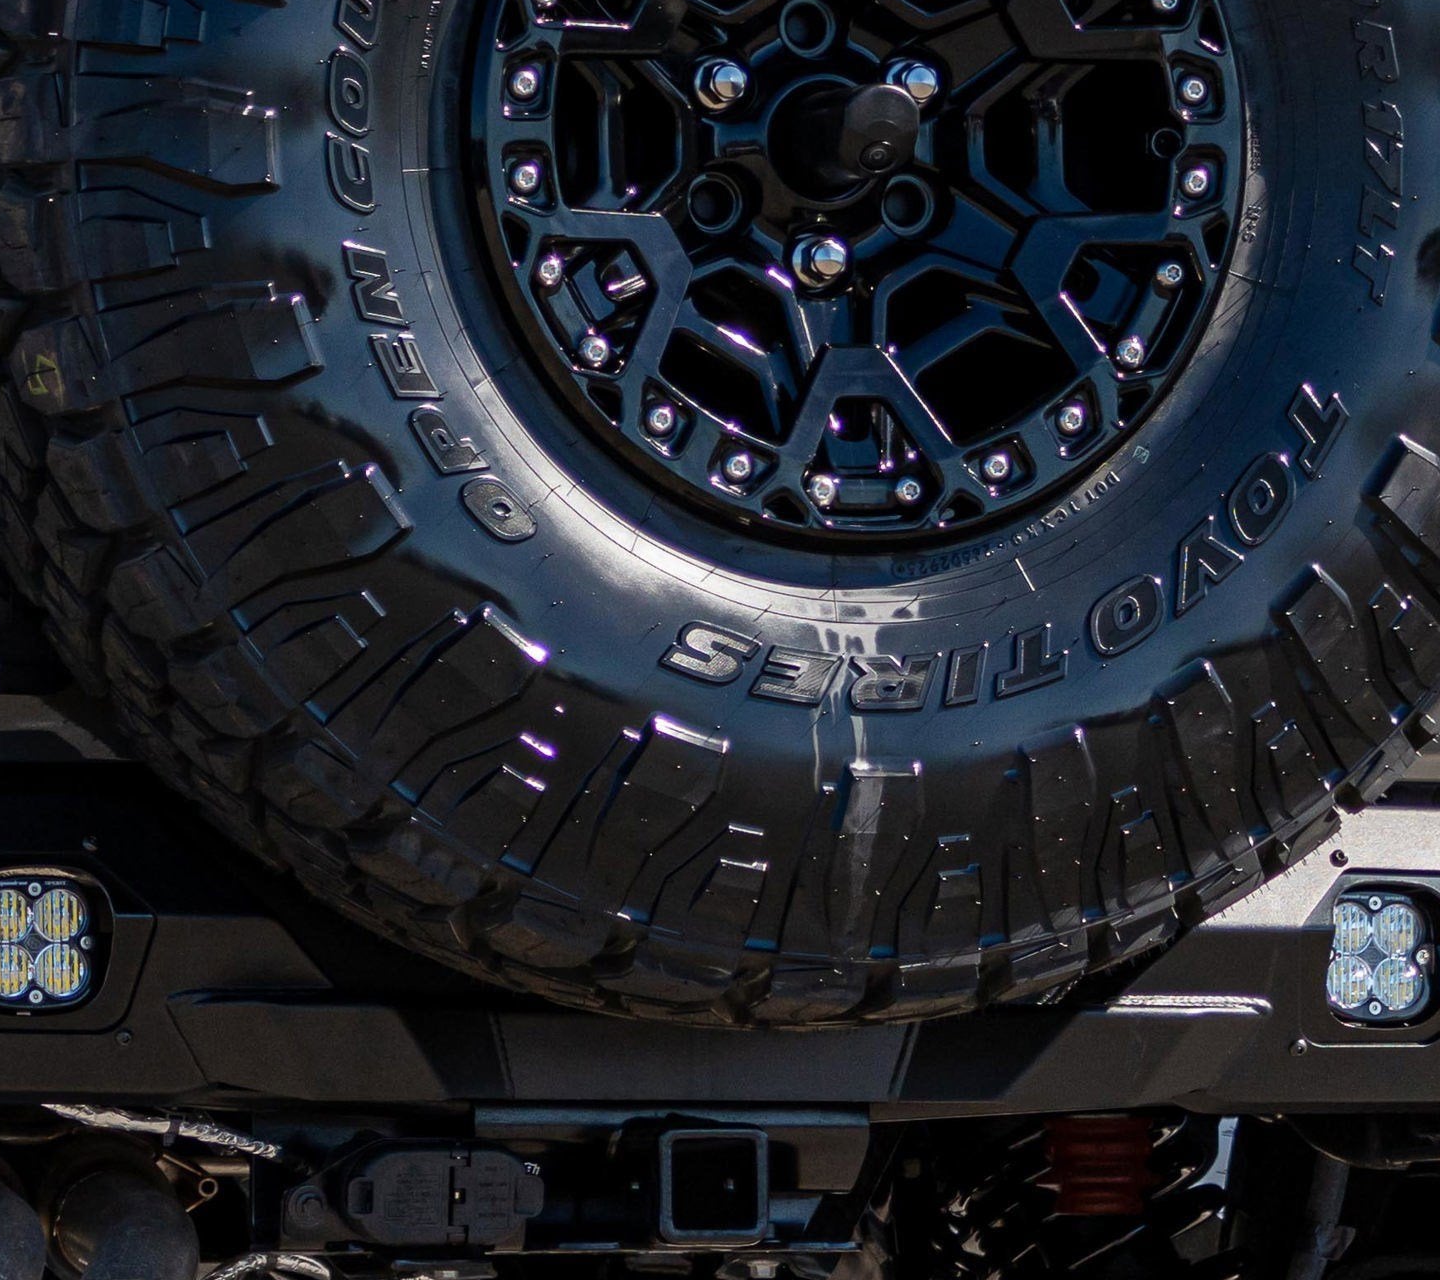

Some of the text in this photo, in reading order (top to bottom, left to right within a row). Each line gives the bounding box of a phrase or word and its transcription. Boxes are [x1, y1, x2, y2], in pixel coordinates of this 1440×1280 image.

[342, 237, 539, 544] OPEN
[656, 382, 1350, 712] TOYO TIRES
